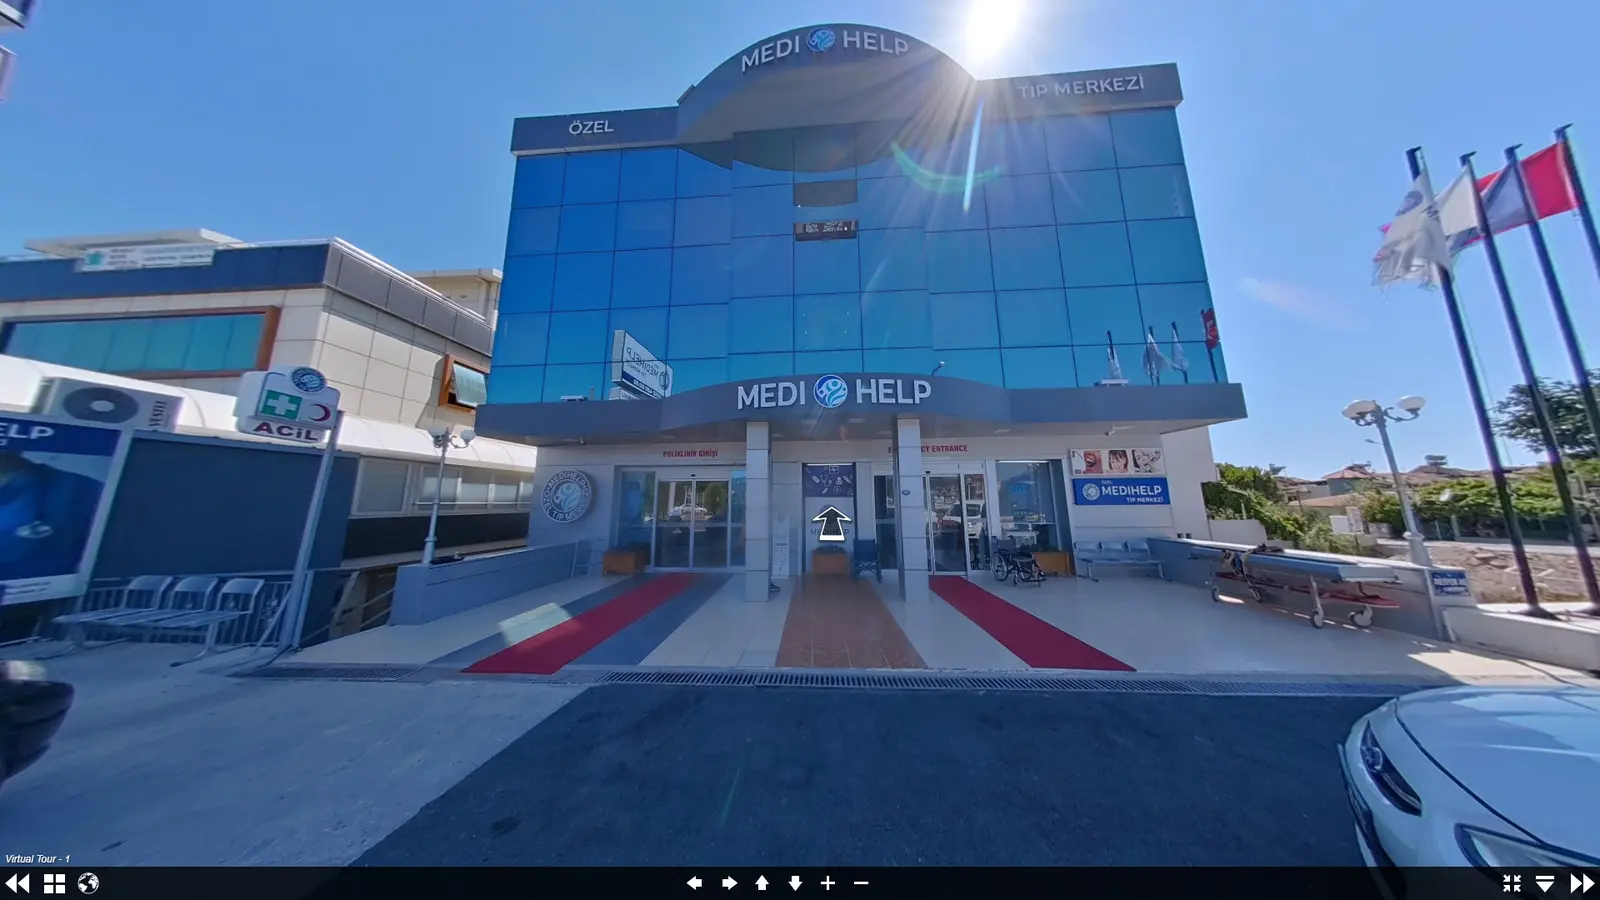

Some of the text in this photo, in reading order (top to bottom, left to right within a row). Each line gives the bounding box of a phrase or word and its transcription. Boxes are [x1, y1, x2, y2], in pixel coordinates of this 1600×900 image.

[741, 30, 909, 72] MEDI HELP
[1017, 73, 1145, 98] TIP MERKEZİ
[569, 120, 614, 135] ÖZEL
[737, 378, 932, 410] MEDI HELP
[931, 444, 968, 453] ENTRANCE
[1101, 485, 1162, 496] MEDIHELP
